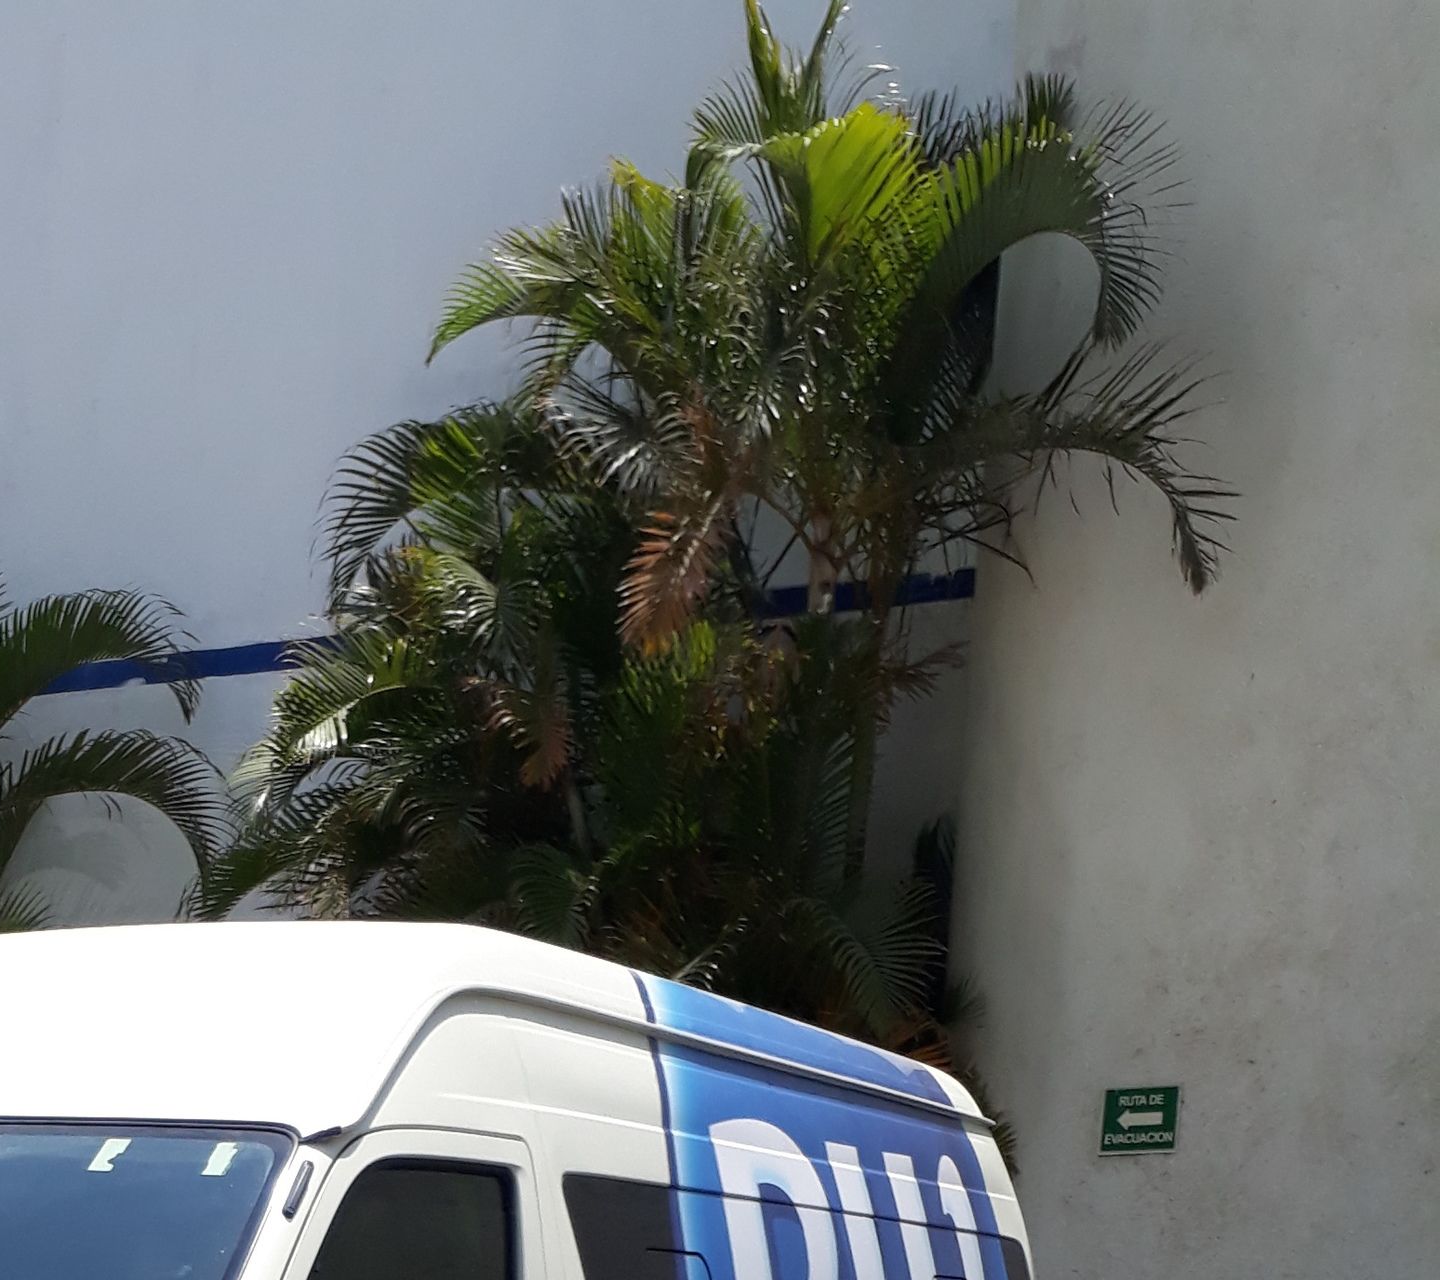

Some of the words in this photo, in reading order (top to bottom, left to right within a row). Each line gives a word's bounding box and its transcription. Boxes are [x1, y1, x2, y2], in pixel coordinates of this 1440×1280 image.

[1118, 1095, 1147, 1107] RUTA
[1149, 1094, 1166, 1105] DE
[1103, 1132, 1174, 1145] EVACUACION
